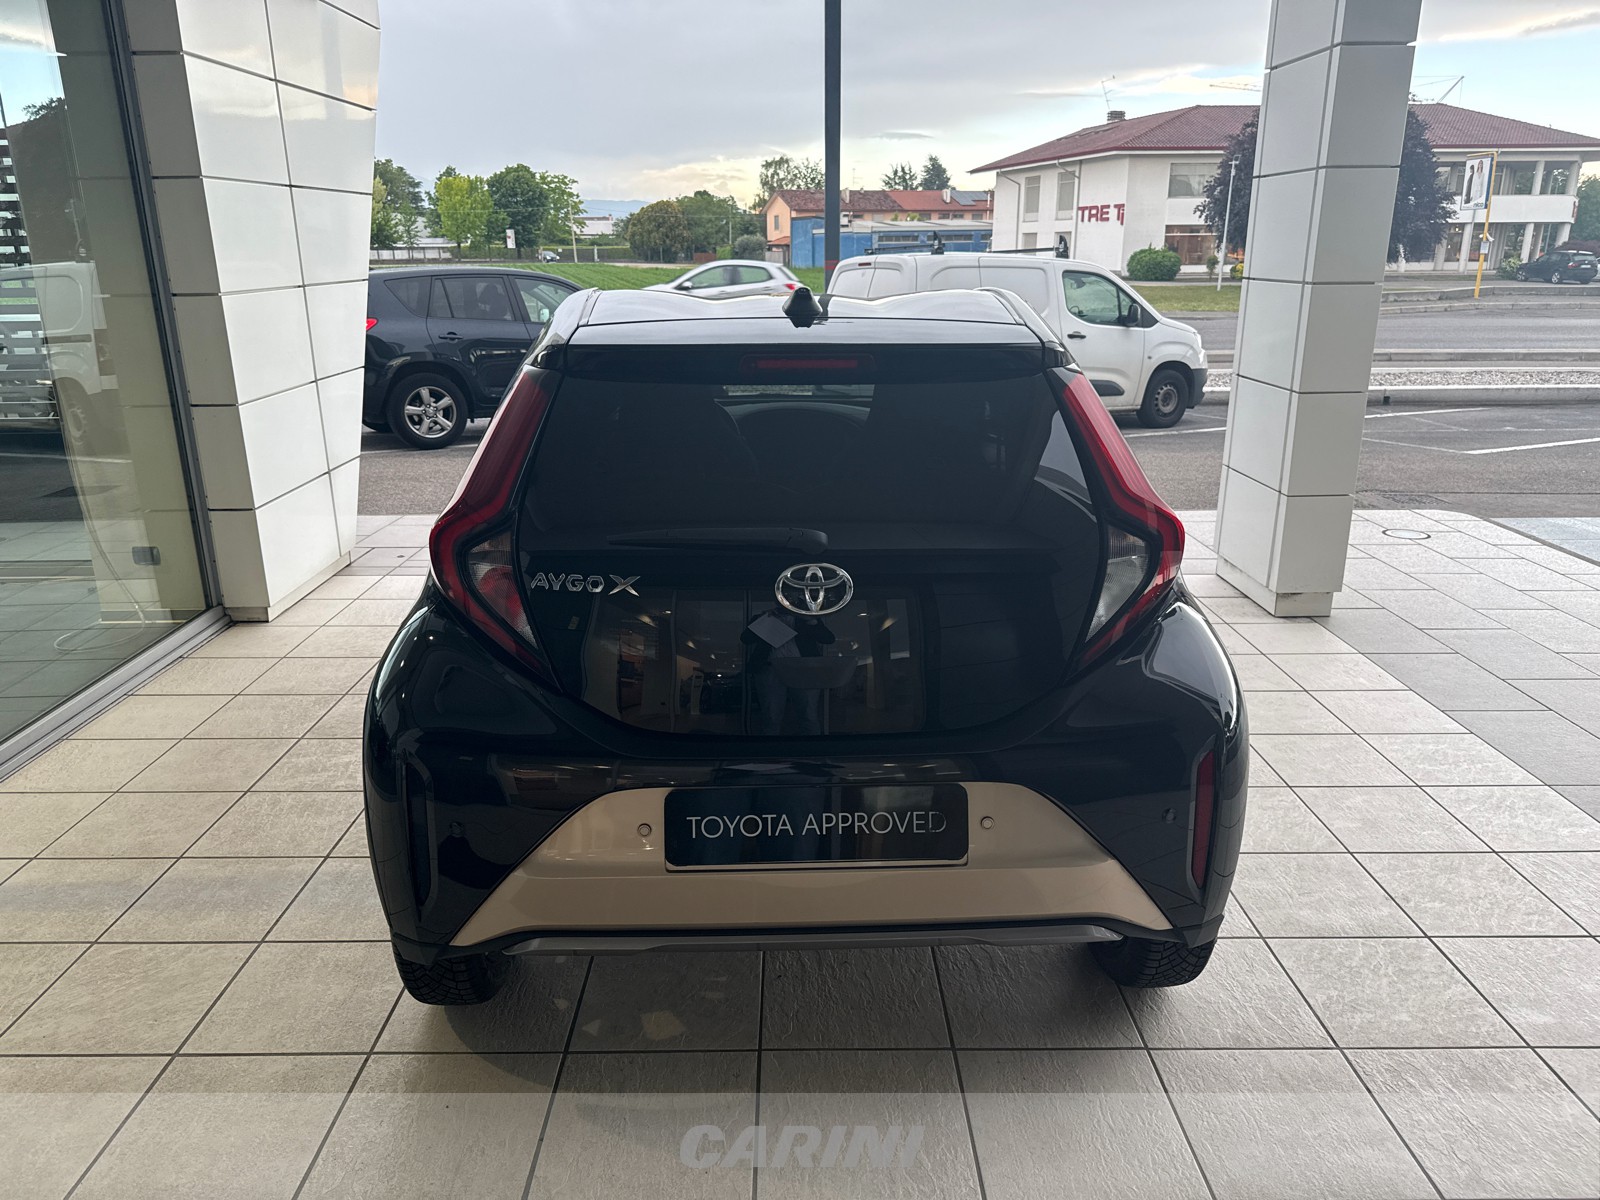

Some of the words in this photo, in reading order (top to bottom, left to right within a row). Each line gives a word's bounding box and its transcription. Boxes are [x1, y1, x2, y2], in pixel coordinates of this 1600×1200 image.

[1077, 204, 1110, 222] TRE
[686, 814, 794, 839] TOYOTA
[802, 811, 946, 836] APPROVED
